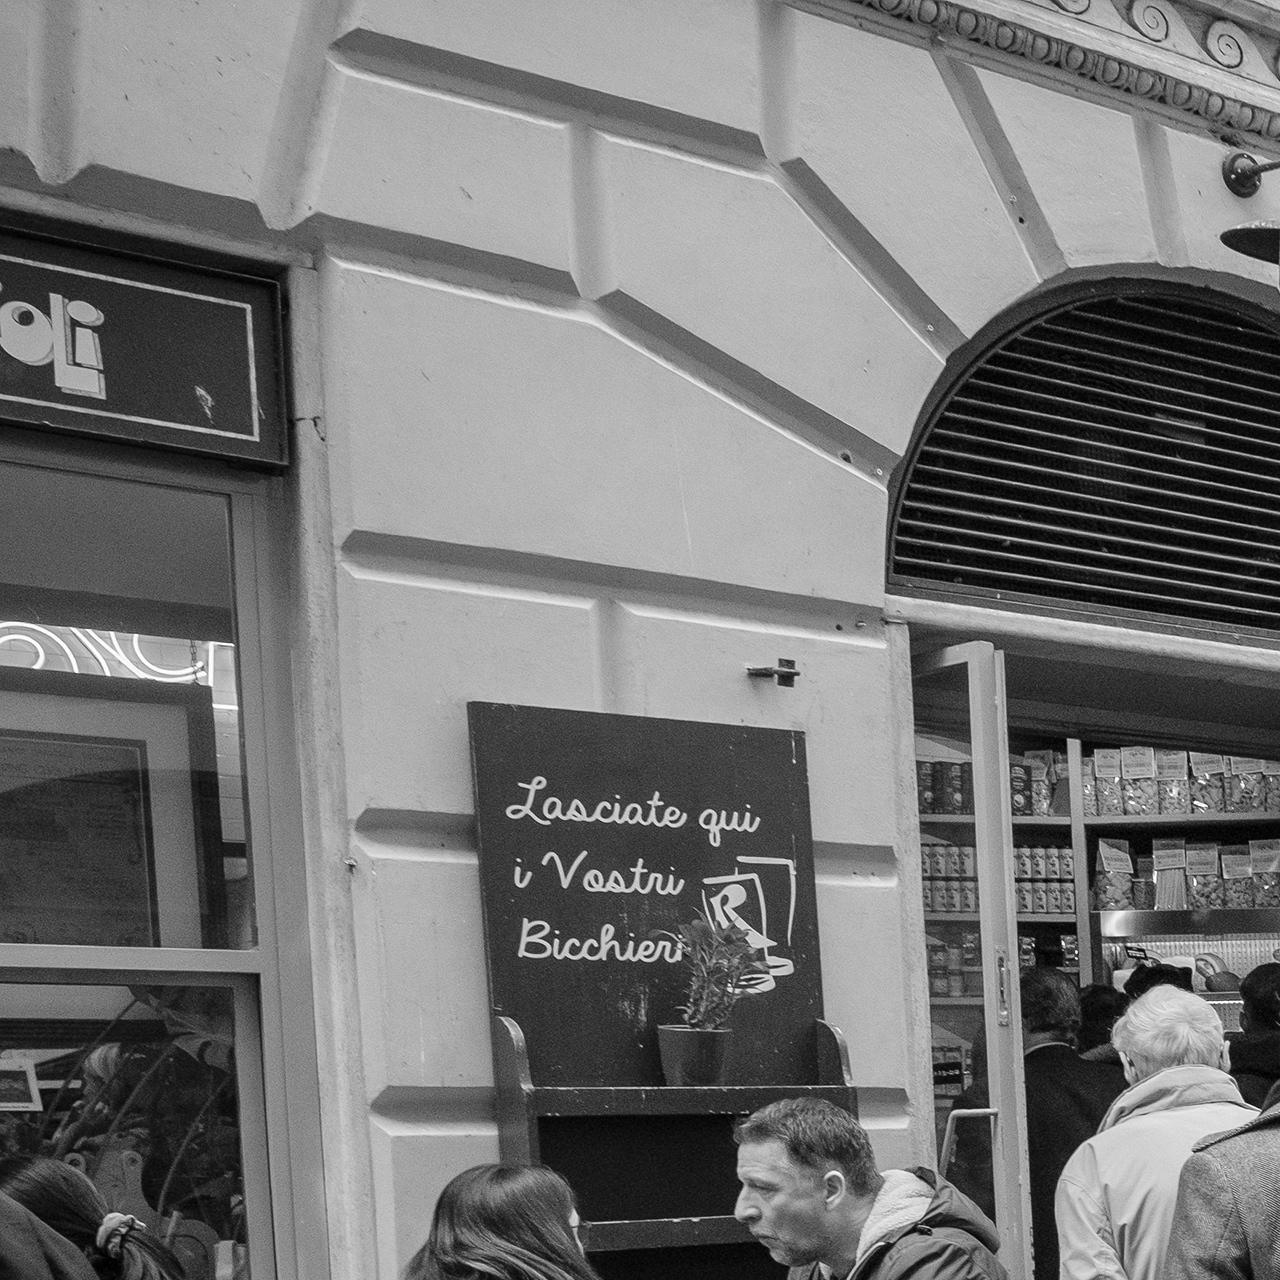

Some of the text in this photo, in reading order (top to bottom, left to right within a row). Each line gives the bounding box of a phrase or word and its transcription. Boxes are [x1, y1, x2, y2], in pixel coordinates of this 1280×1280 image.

[506, 775, 760, 846] Lasciate qui
[513, 850, 685, 896] i Vostri
